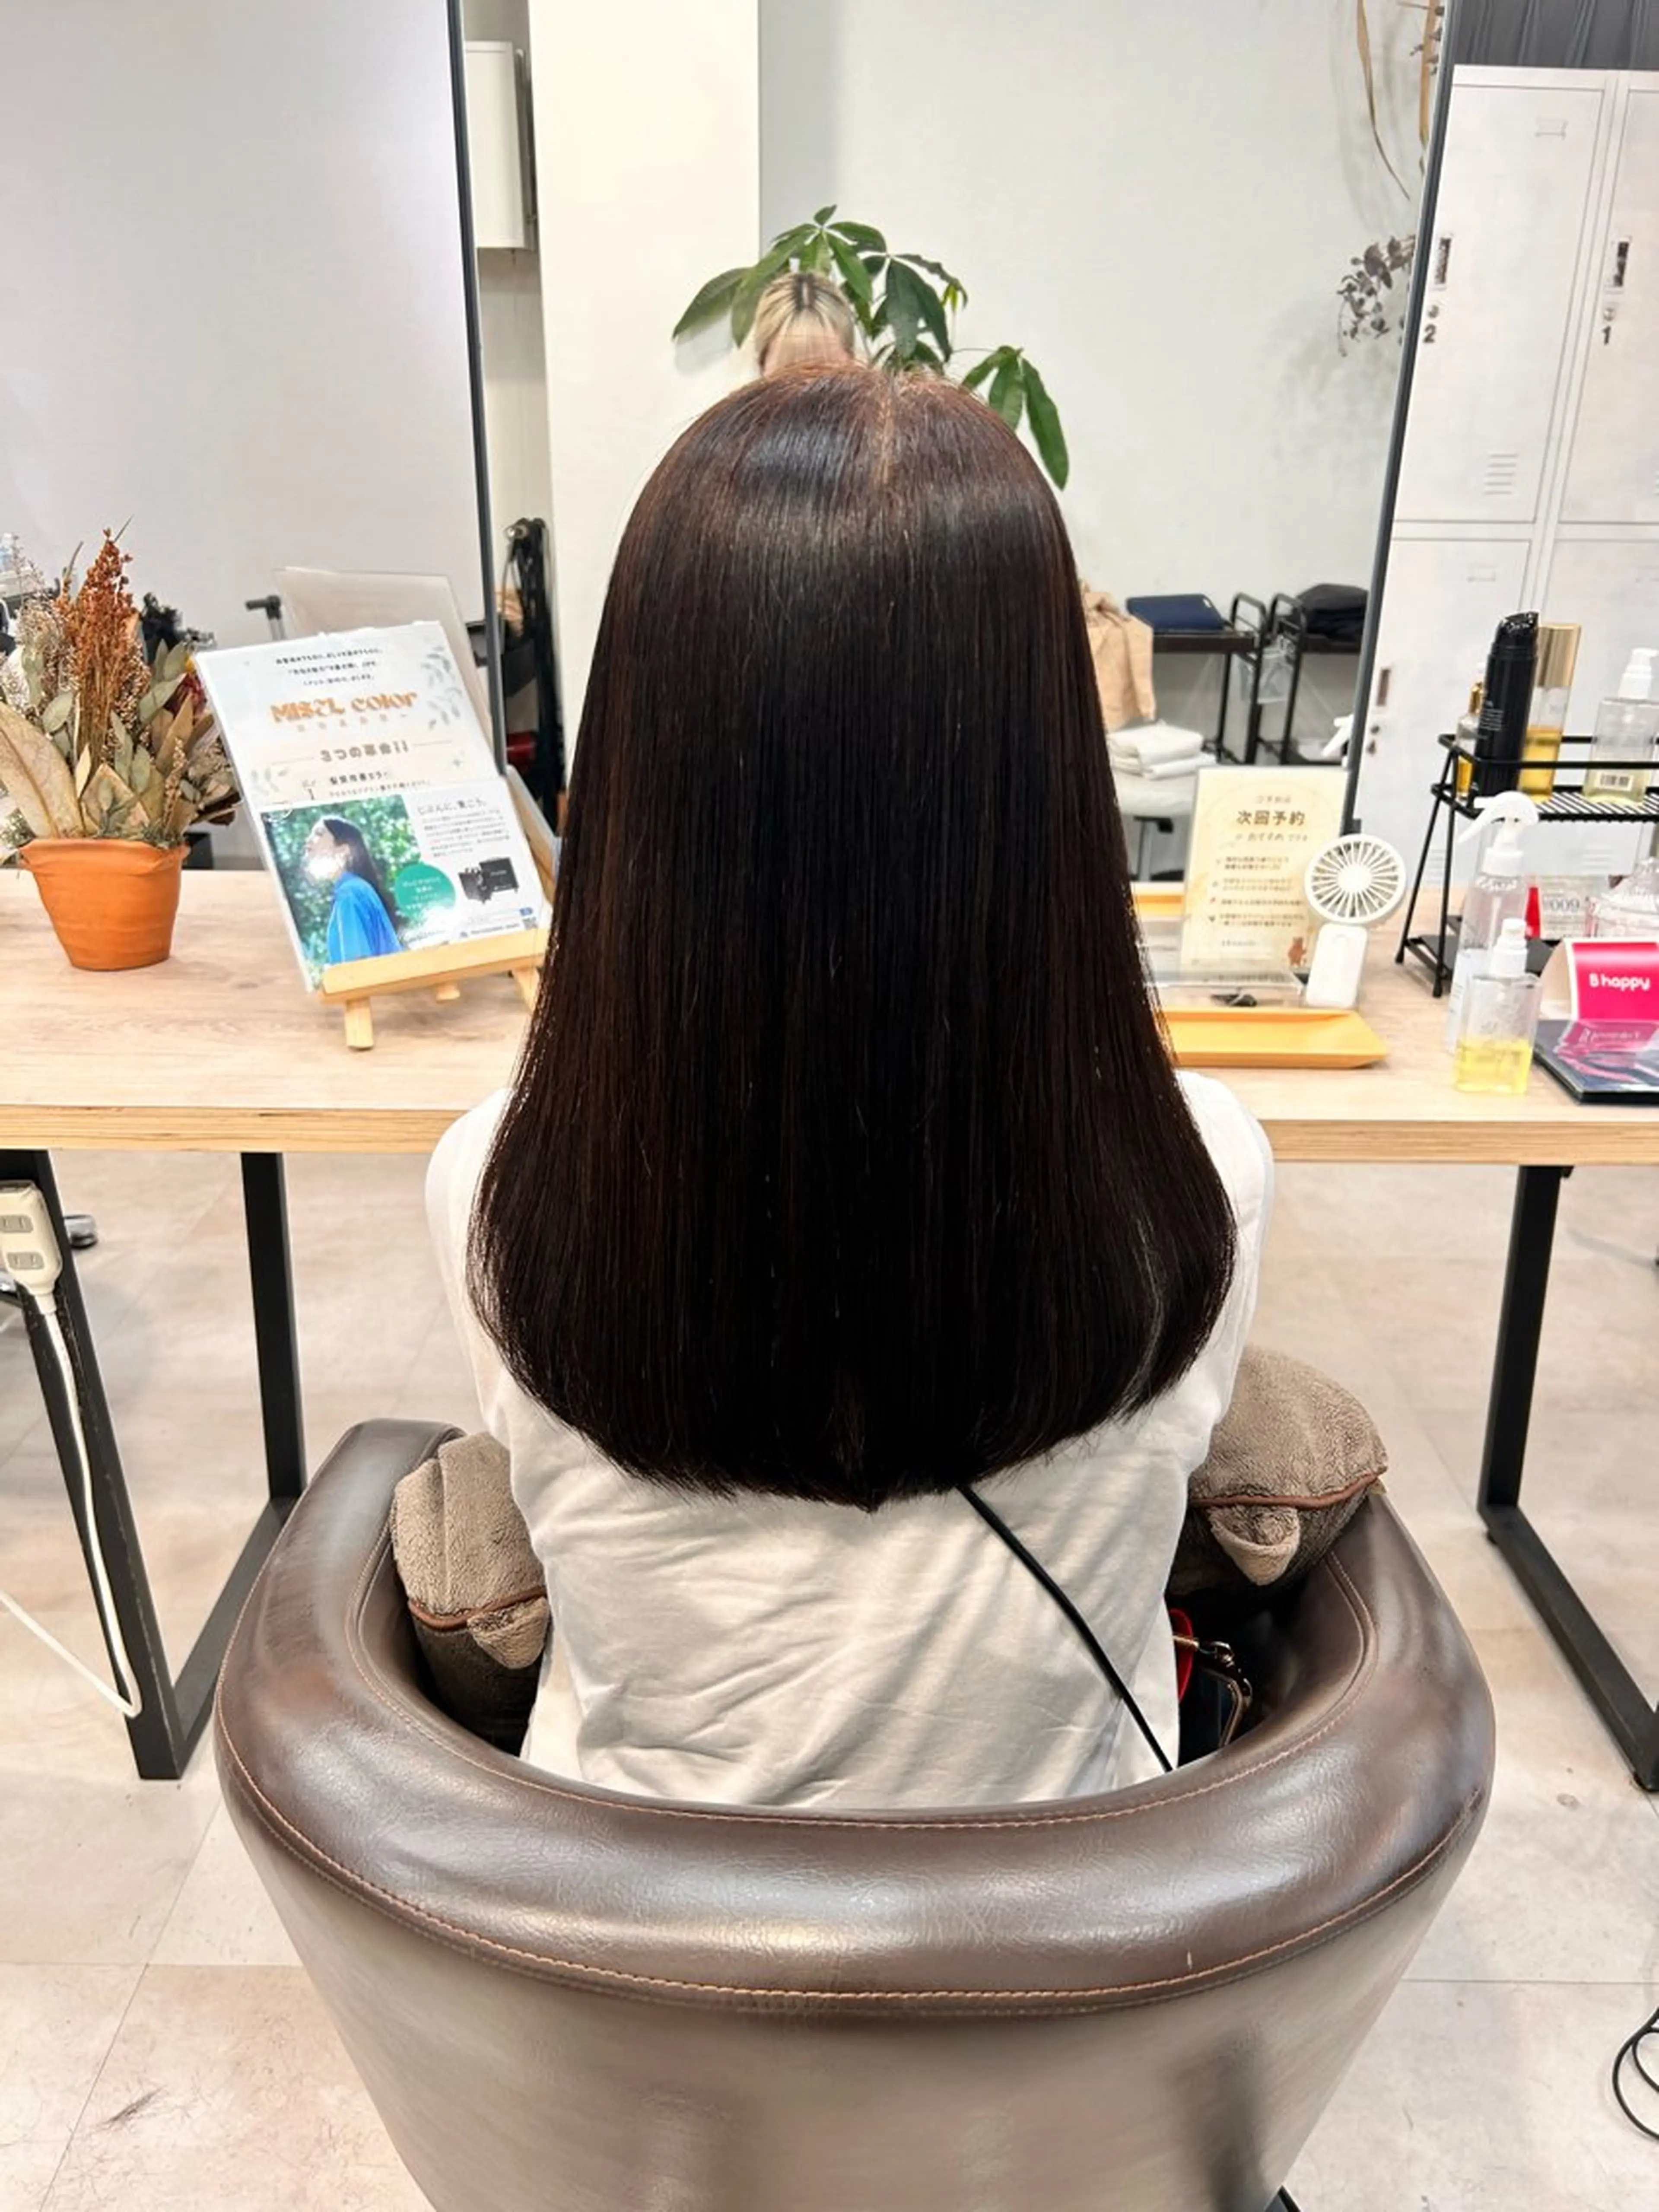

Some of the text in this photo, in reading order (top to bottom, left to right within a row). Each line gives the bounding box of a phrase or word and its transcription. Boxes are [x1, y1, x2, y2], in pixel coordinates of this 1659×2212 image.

[1423, 323, 1437, 344] 2
[1601, 325, 1611, 346] 1
[1236, 809, 1306, 826] 次回予約
[1589, 973, 1651, 992] B happy
